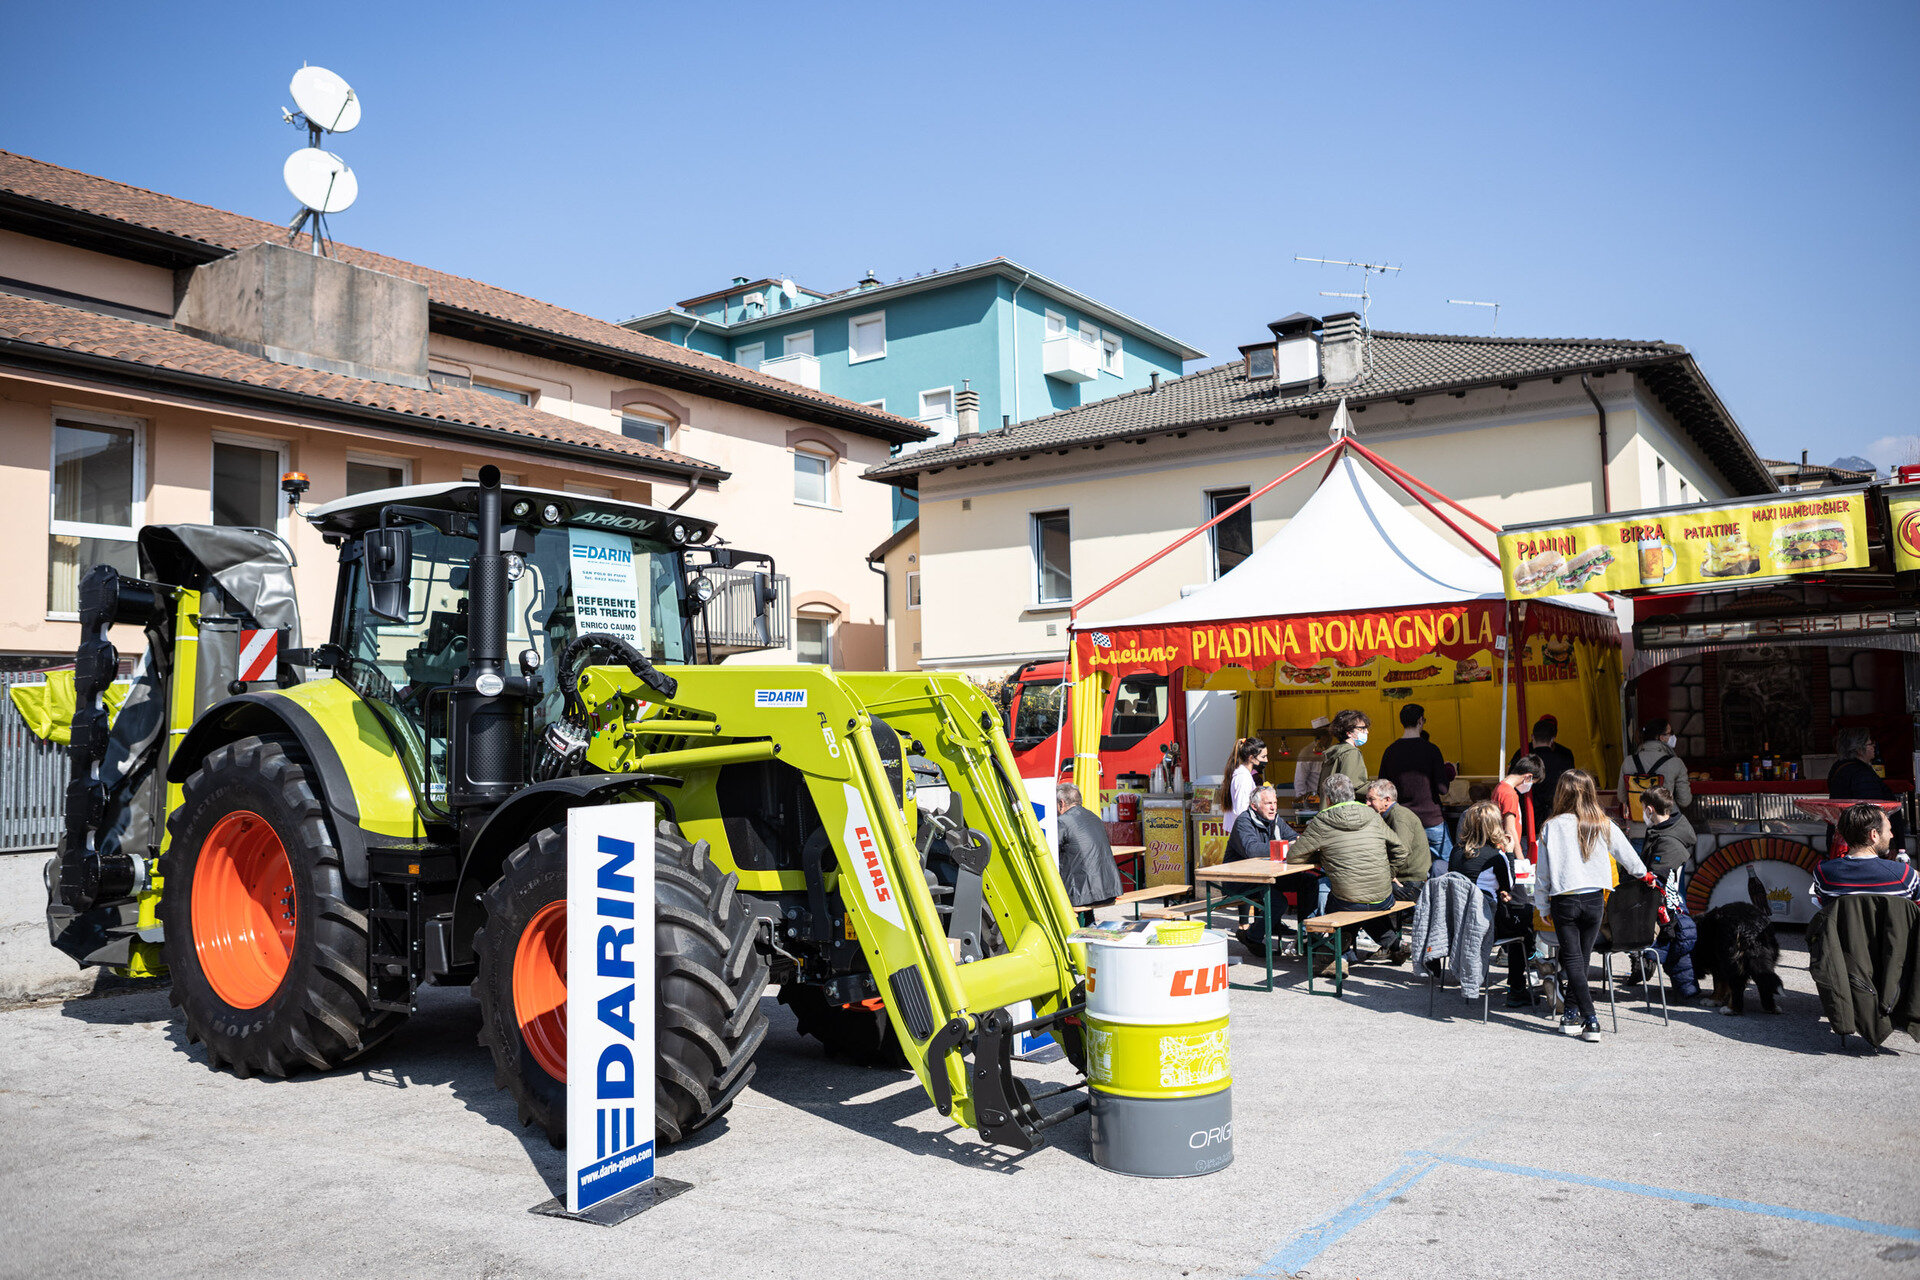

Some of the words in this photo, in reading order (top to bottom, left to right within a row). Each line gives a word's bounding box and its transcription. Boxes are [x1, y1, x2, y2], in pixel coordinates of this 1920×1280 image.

[571, 511, 656, 531] ARION
[1751, 507, 1777, 523] MAXI
[1778, 499, 1851, 520] HAMBURGHER
[1619, 523, 1666, 544] BIRRA
[1683, 521, 1741, 541] PATATINE
[1516, 534, 1577, 560] PANINI
[576, 595, 636, 609] REFERENTE
[578, 606, 597, 616] PER
[599, 607, 637, 619] TRENTO
[580, 621, 608, 630] ENRICO
[610, 622, 636, 632] CAUMO
[1192, 623, 1301, 661] PIADINA
[1308, 610, 1493, 653] ROMAGNOLA
[1089, 639, 1179, 666] Luciano
[1337, 669, 1373, 678] PROSCIUTTO
[854, 825, 891, 903] CLAAS
[1169, 963, 1229, 998] CLA
[580, 1147, 653, 1187] www.darin-piave.com
